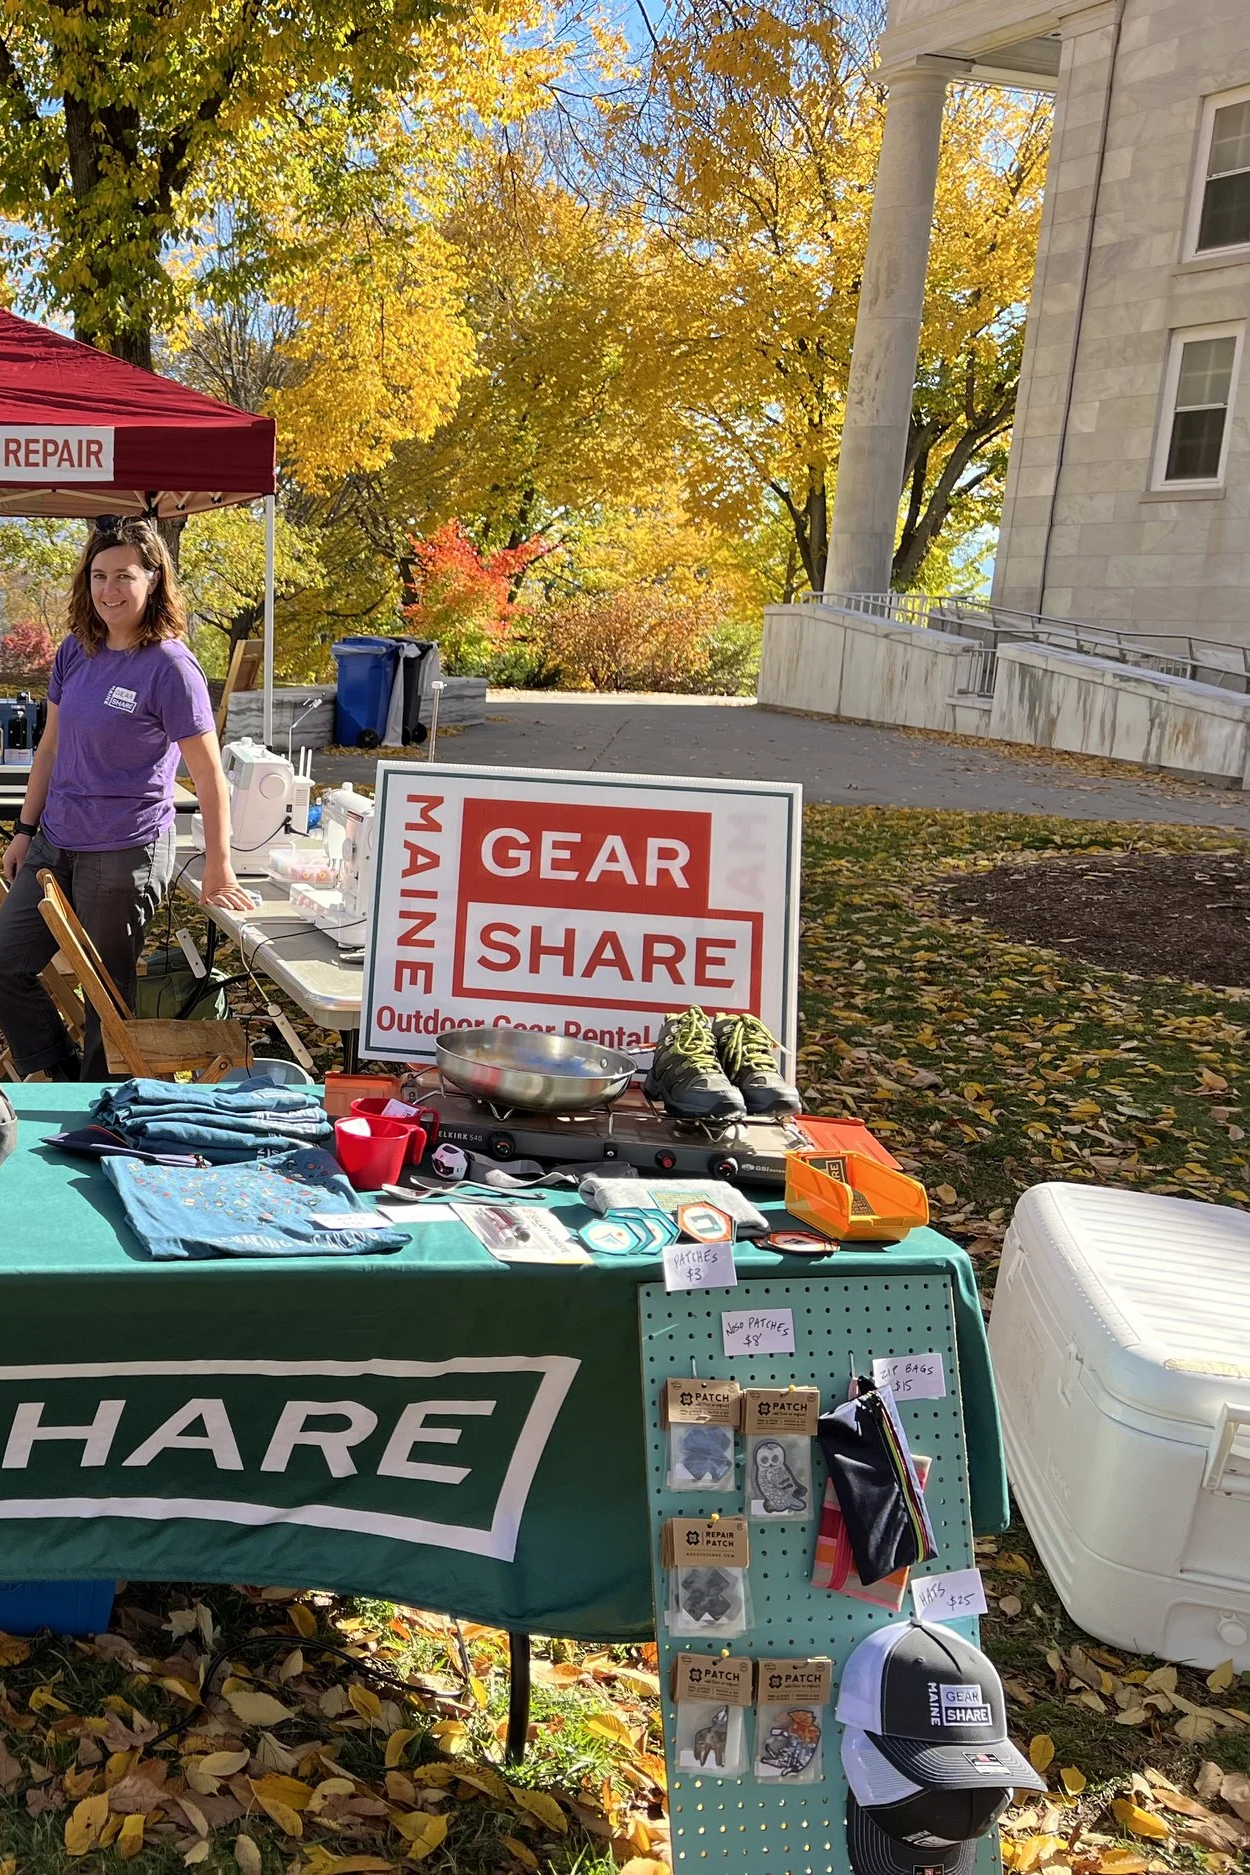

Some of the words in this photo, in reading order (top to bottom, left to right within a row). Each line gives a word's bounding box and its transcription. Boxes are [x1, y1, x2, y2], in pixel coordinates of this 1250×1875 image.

[3, 438, 104, 468] REPAIR
[480, 827, 691, 889] GEAR
[394, 794, 445, 995] MAINE
[476, 922, 737, 989] SHARE
[438, 1130, 468, 1140] ELKIRK
[469, 1134, 483, 1142] 540
[686, 1267, 703, 1282] $3
[880, 1364, 899, 1380] ZIP
[905, 1363, 935, 1376] BAGS
[891, 1379, 914, 1392] $15
[695, 1392, 730, 1402] PATCH
[772, 1402, 808, 1411] PATCH
[705, 1531, 734, 1539] REPAIR
[705, 1540, 734, 1548] PATCH
[918, 1582, 946, 1607] HATS
[946, 1592, 975, 1612] $25
[704, 1669, 740, 1681] PATCH
[784, 1674, 822, 1683] PATCH
[945, 1691, 979, 1702] GEAR
[927, 1682, 941, 1726] MAINE
[947, 1708, 988, 1721] SHARE
